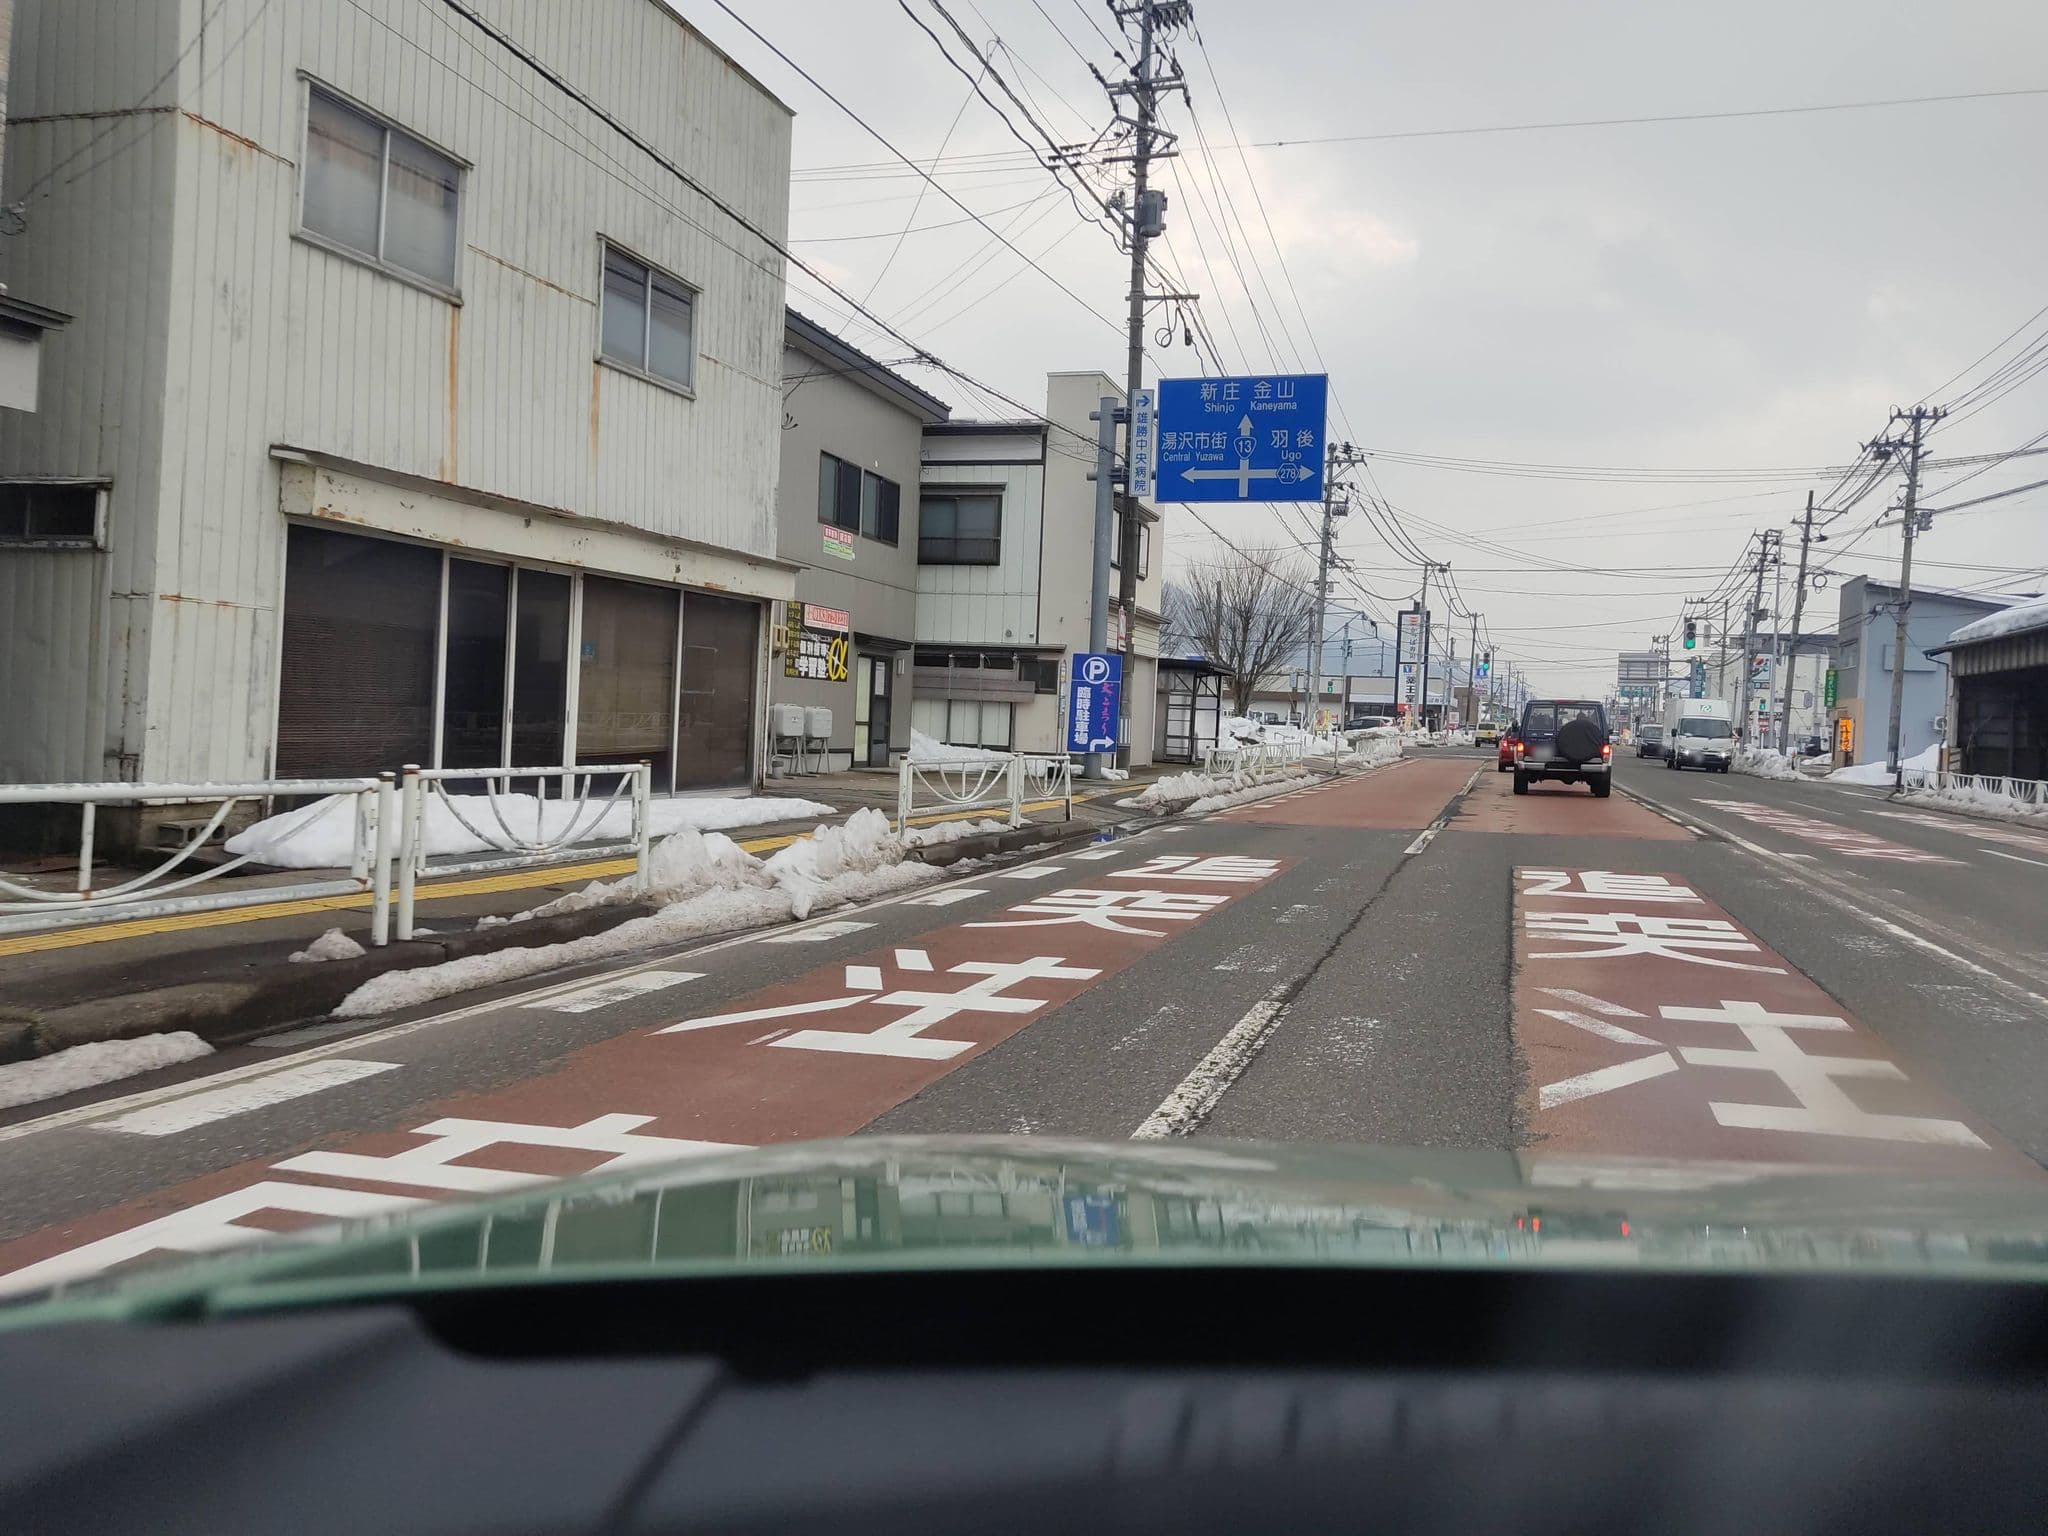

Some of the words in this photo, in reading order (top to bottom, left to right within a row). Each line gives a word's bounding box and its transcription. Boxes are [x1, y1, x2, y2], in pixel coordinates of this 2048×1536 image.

[1200, 382, 1241, 401] 新庄
[1253, 380, 1295, 400] 金山
[1204, 402, 1235, 414] Shinjo
[1250, 400, 1297, 412] Kaneyama
[1161, 431, 1227, 451] 湯沢市街
[1237, 438, 1252, 453] 13
[1270, 429, 1315, 449] 羽後
[1133, 411, 1149, 492] 雄勝中央病院
[1163, 451, 1191, 462] Central
[1195, 450, 1224, 462] Yuzawa
[1281, 450, 1302, 462] Ugo
[1280, 468, 1296, 480] 278
[1089, 660, 1105, 681] P
[1074, 686, 1092, 745] 臨時駐車場
